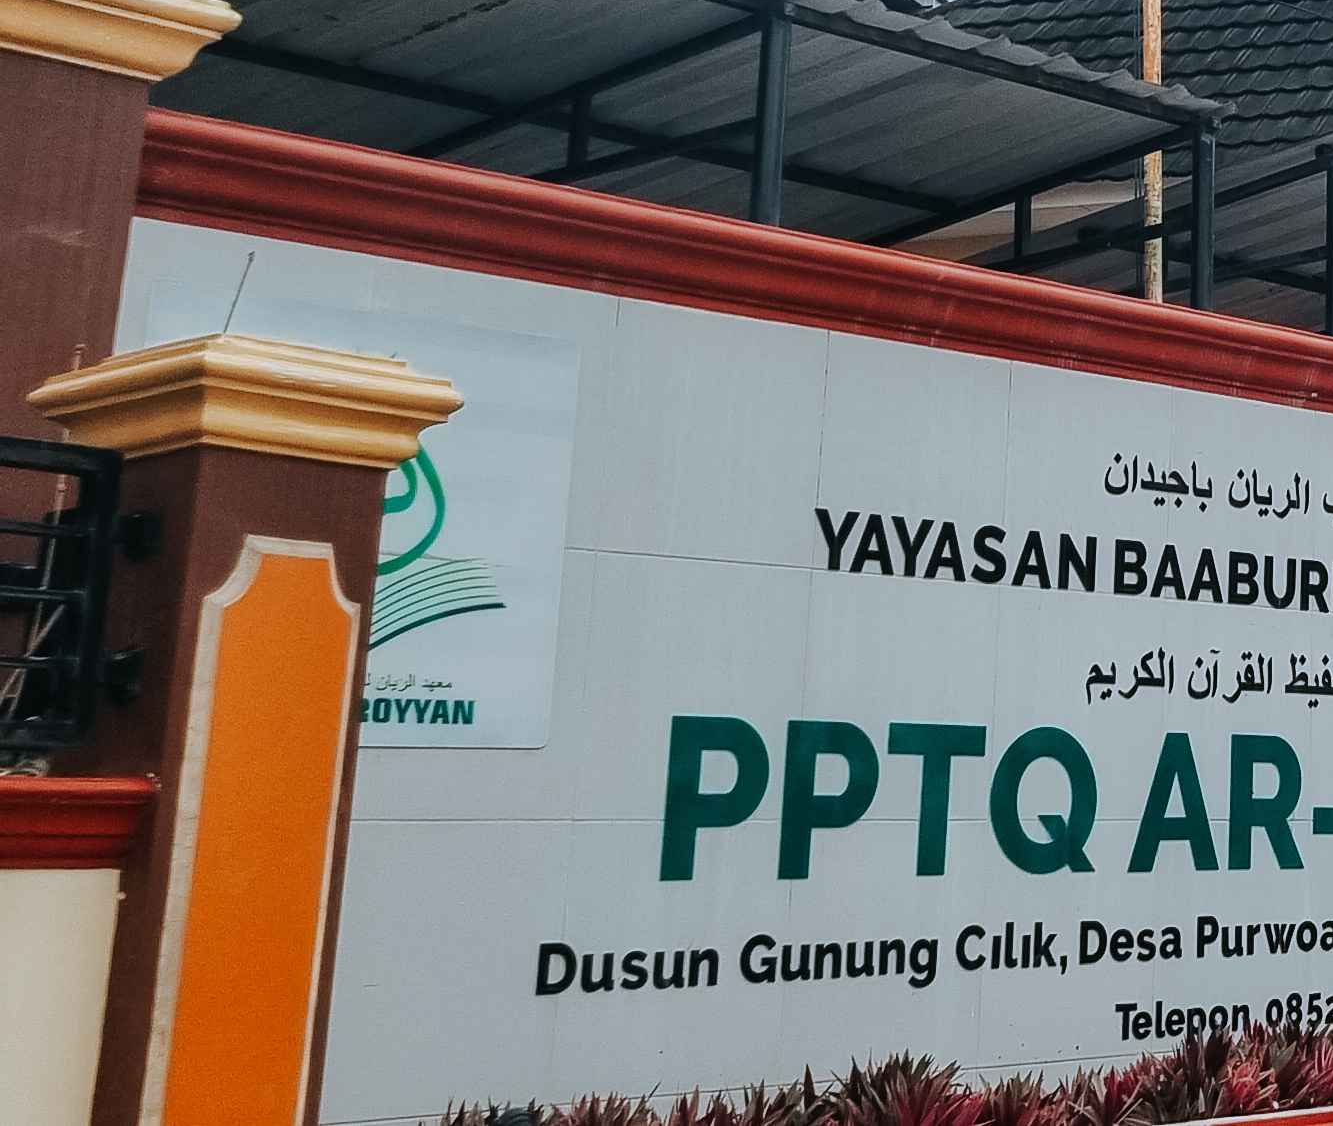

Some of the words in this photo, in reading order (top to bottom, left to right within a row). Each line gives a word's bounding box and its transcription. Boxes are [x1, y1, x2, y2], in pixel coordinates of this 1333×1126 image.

[1228, 468, 1310, 520] الريان
[814, 507, 1098, 593] YAYASAN
[1085, 646, 1175, 706] الكريم
[659, 715, 1098, 882] PPTQ
[534, 942, 720, 996] Dusun
[739, 933, 939, 990] Gunung
[1078, 919, 1183, 965] Desa
[1115, 1000, 1251, 1041] Telepon
